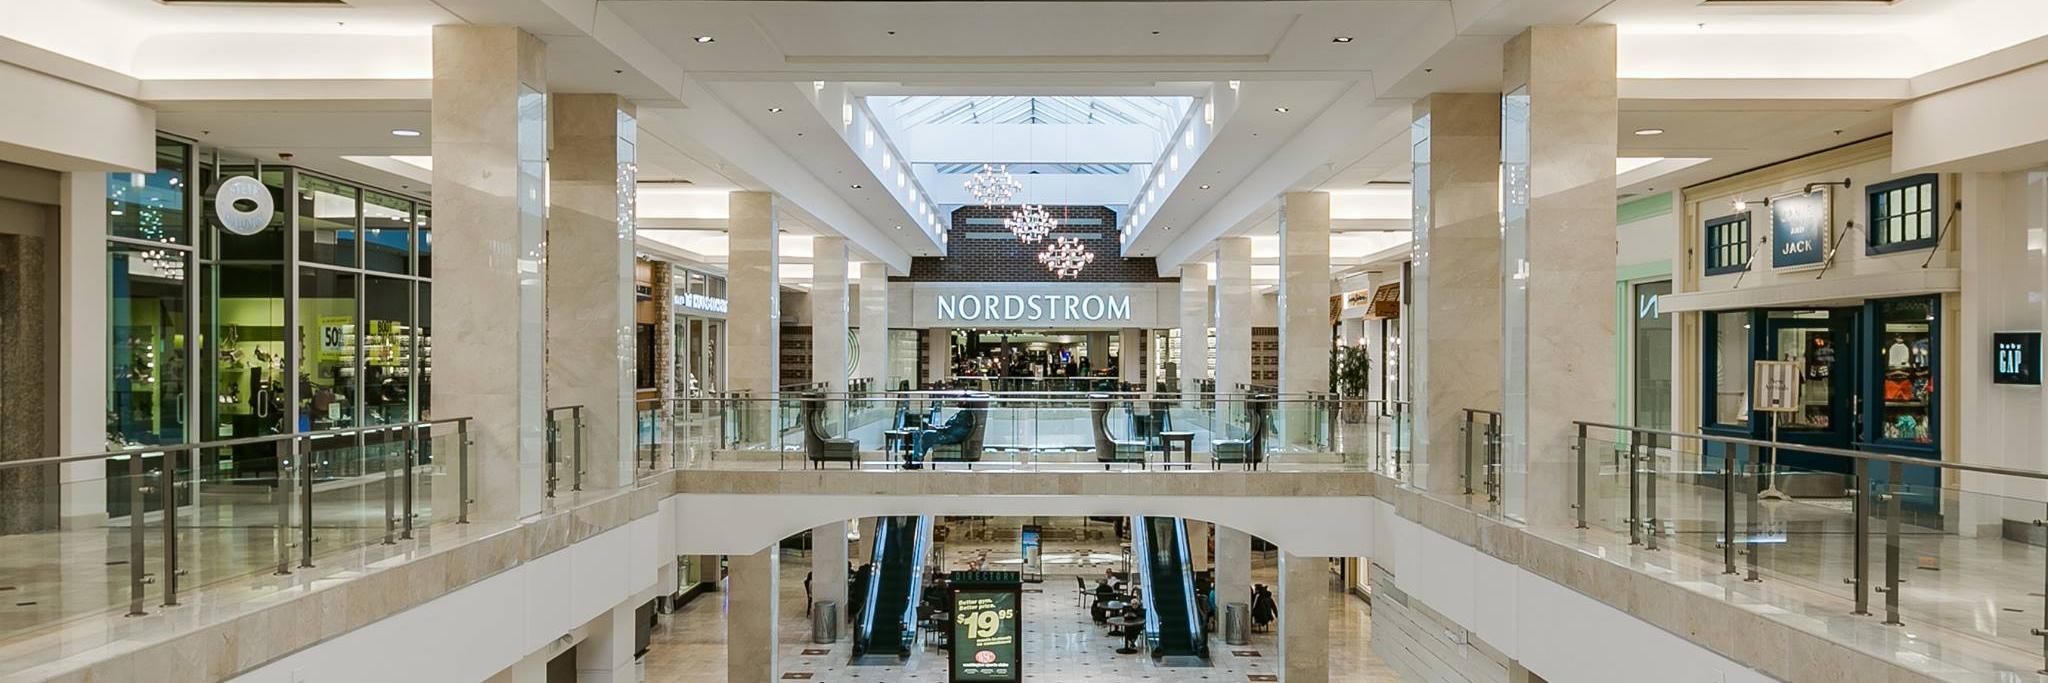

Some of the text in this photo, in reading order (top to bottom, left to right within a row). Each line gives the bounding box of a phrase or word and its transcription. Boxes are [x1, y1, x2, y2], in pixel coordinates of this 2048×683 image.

[1782, 240, 1812, 255] JACK
[937, 295, 1131, 320] NORDSTROM
[1999, 350, 2022, 373] GAP
[956, 571, 1015, 580] DIRECTORY
